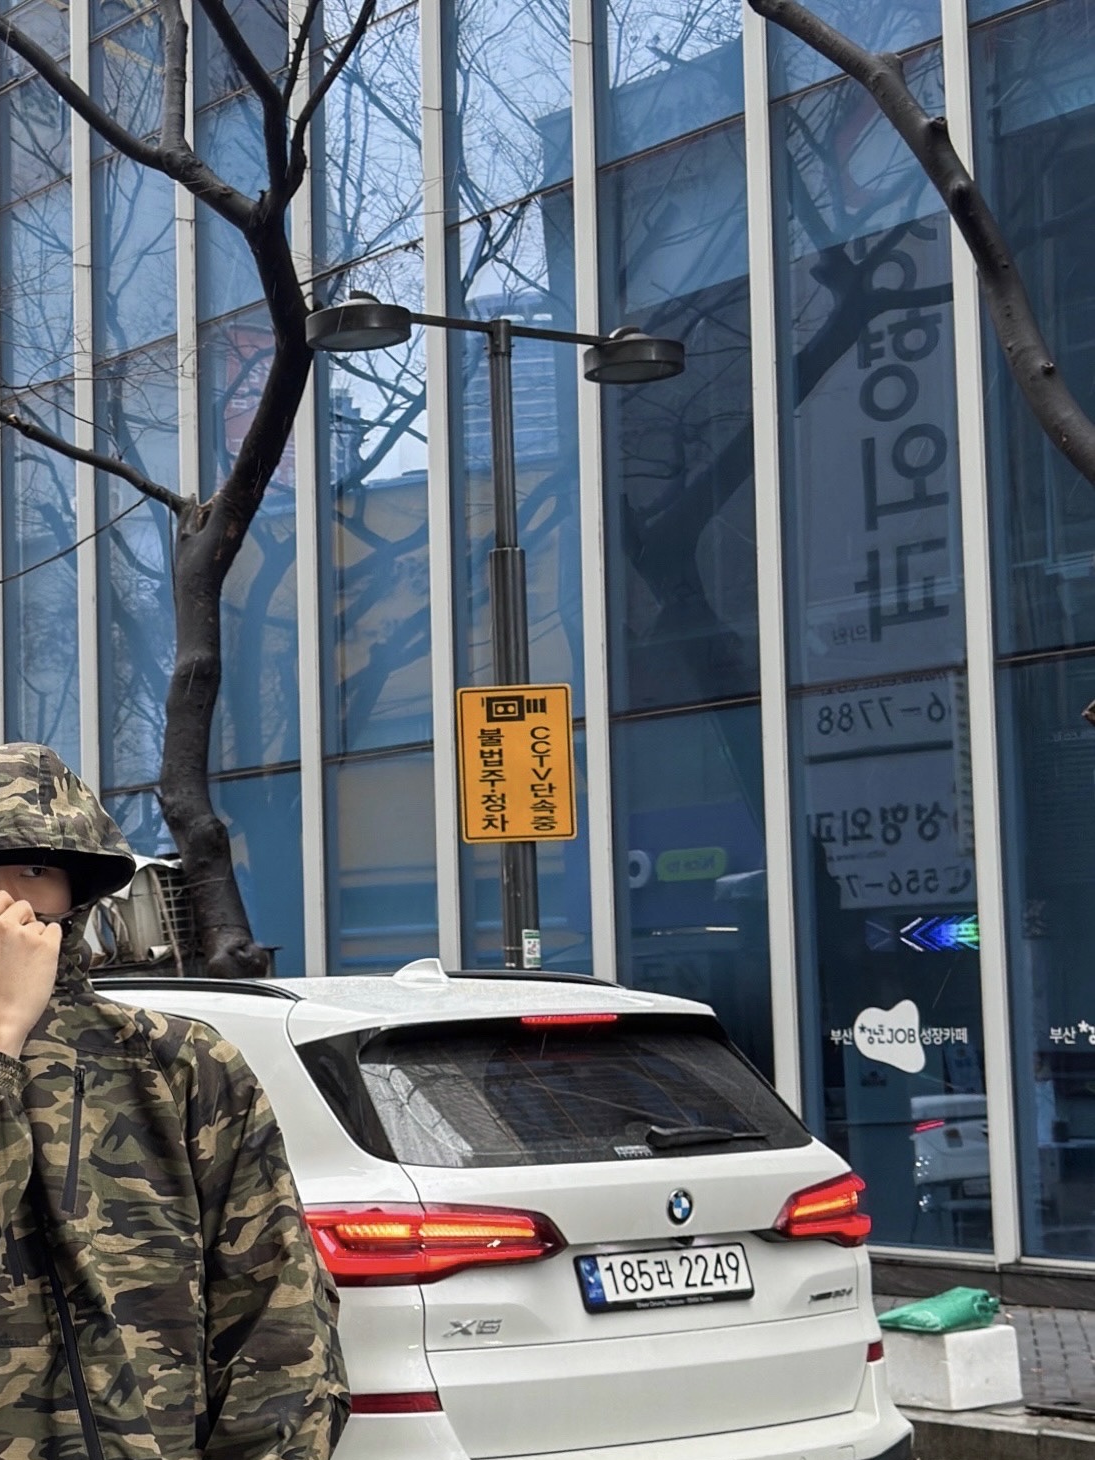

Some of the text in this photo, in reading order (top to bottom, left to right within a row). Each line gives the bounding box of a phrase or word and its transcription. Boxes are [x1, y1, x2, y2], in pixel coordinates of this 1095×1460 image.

[830, 1027, 853, 1046] 부산
[919, 1026, 969, 1046] 성장카페
[679, 1251, 740, 1289] 2249
